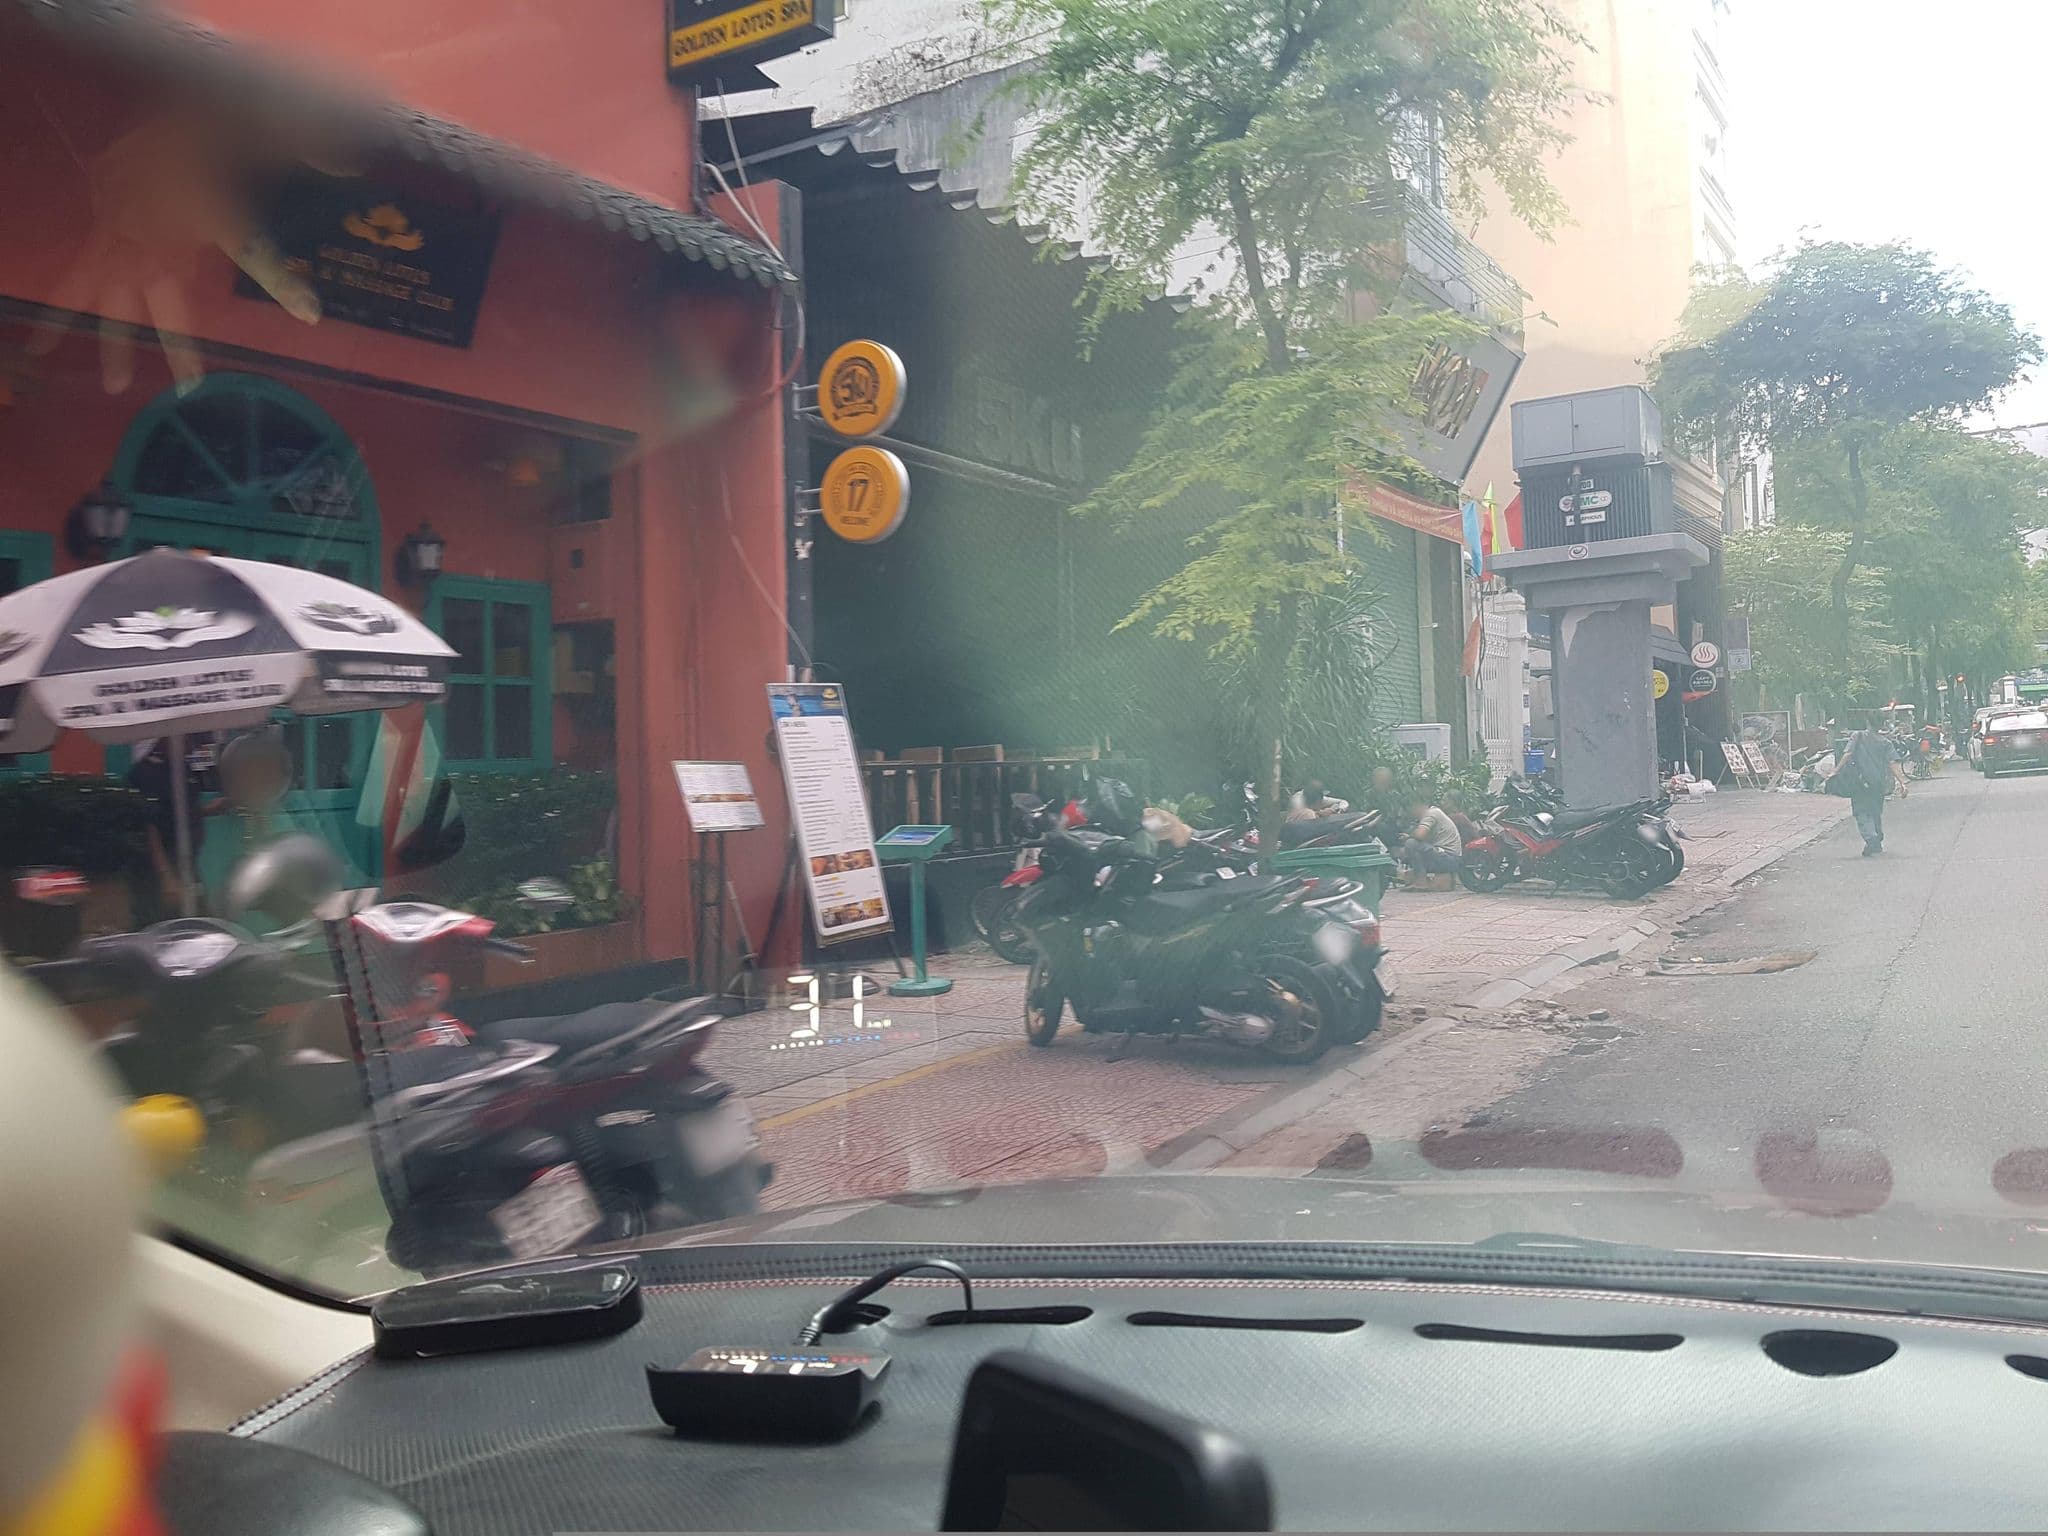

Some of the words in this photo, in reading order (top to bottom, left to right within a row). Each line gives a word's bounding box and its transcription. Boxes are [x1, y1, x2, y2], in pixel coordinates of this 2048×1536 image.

[674, 23, 727, 57] GOLDEN
[732, 8, 776, 39] LOTUS
[780, 0, 809, 22] SPA
[847, 478, 869, 512] 17
[786, 975, 863, 1038] 31
